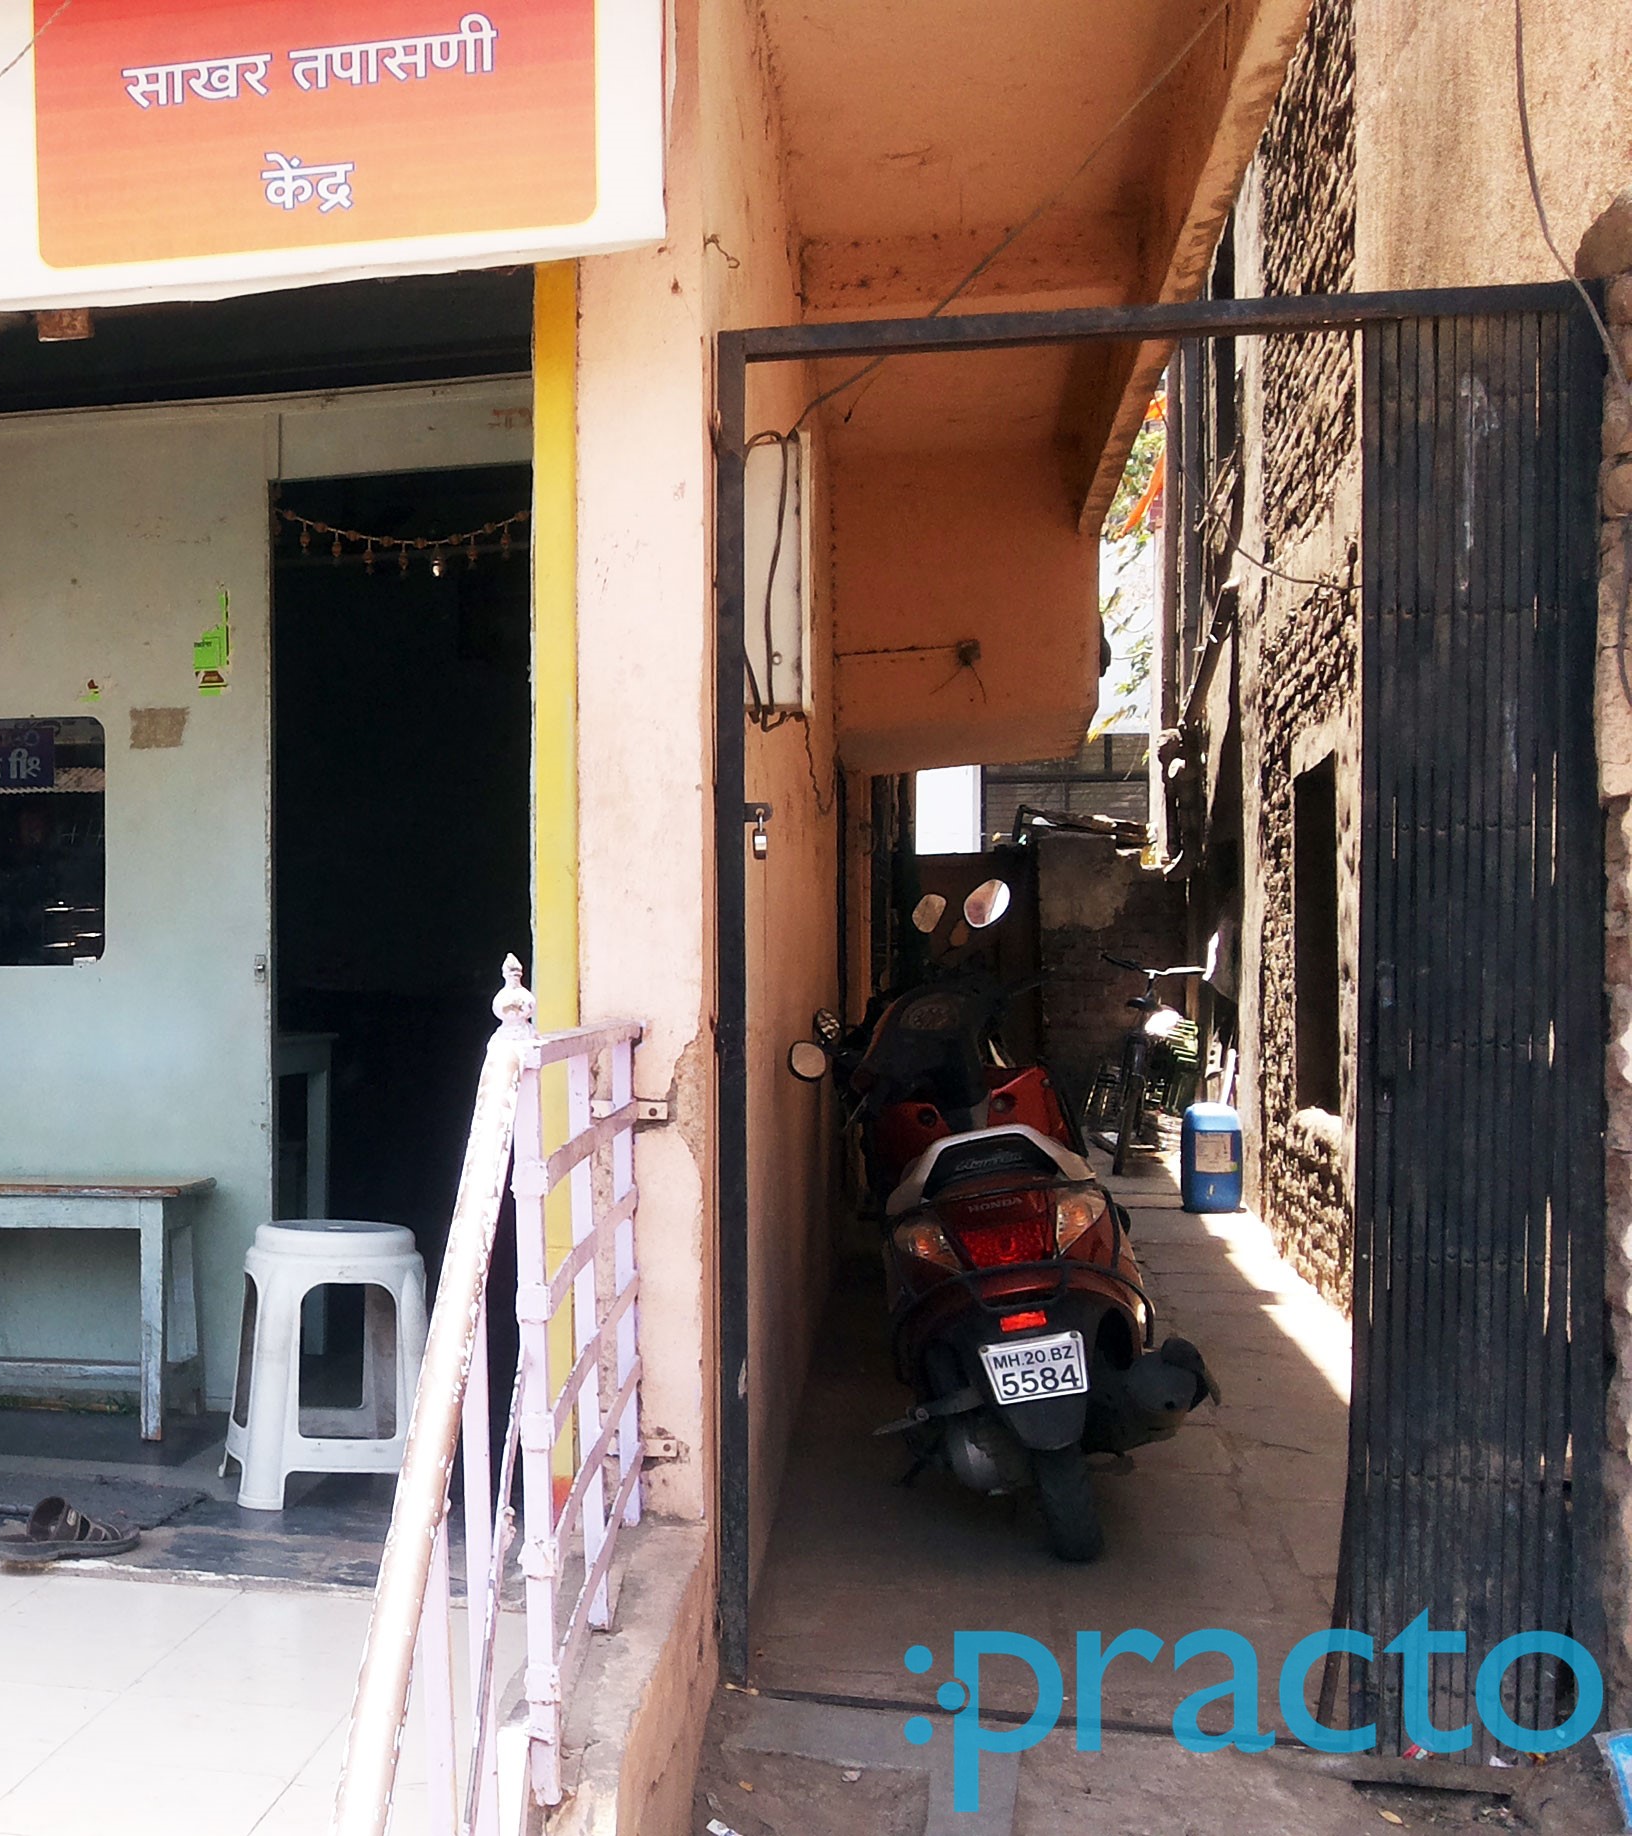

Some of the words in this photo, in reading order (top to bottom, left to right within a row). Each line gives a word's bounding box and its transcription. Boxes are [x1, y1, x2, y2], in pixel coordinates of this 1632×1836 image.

[122, 52, 271, 109] साखर
[288, 13, 497, 91] तपासणी
[261, 152, 355, 212] केंद्र
[968, 1197, 1023, 1213] HONDA
[993, 1345, 1075, 1370] MH.20.BZ
[1002, 1364, 1080, 1396] 5584
